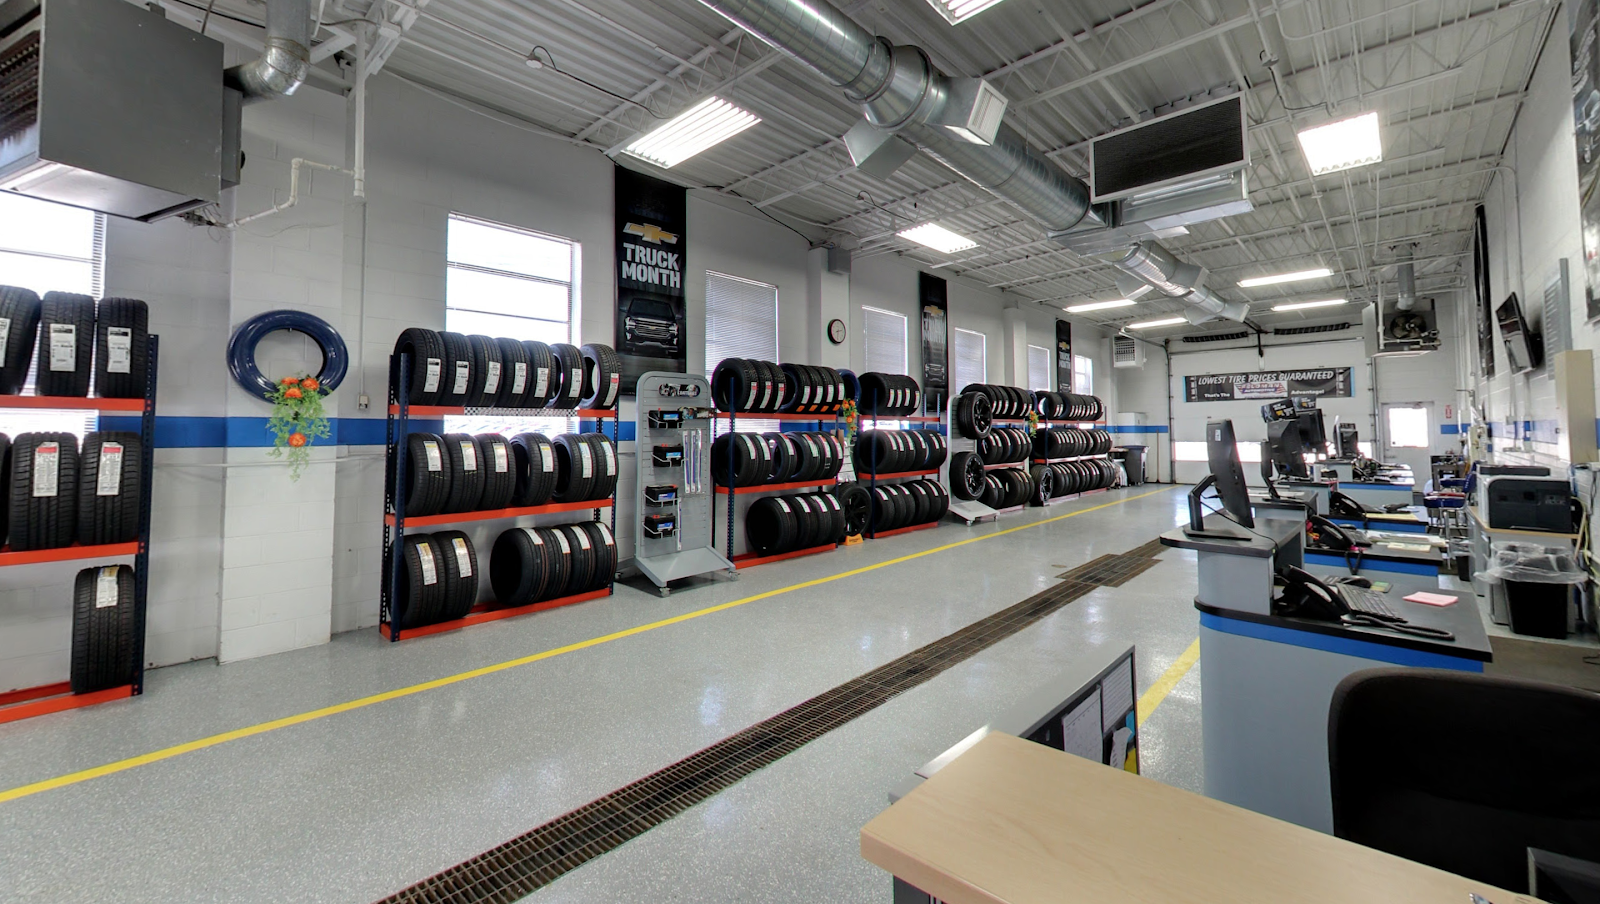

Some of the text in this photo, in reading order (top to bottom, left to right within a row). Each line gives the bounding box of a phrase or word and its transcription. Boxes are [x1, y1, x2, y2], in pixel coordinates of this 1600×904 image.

[623, 243, 680, 271] TRUCK
[621, 261, 681, 288] MONTH
[1198, 370, 1334, 386] LOWEST TIRE PRICES GUARANTEED
